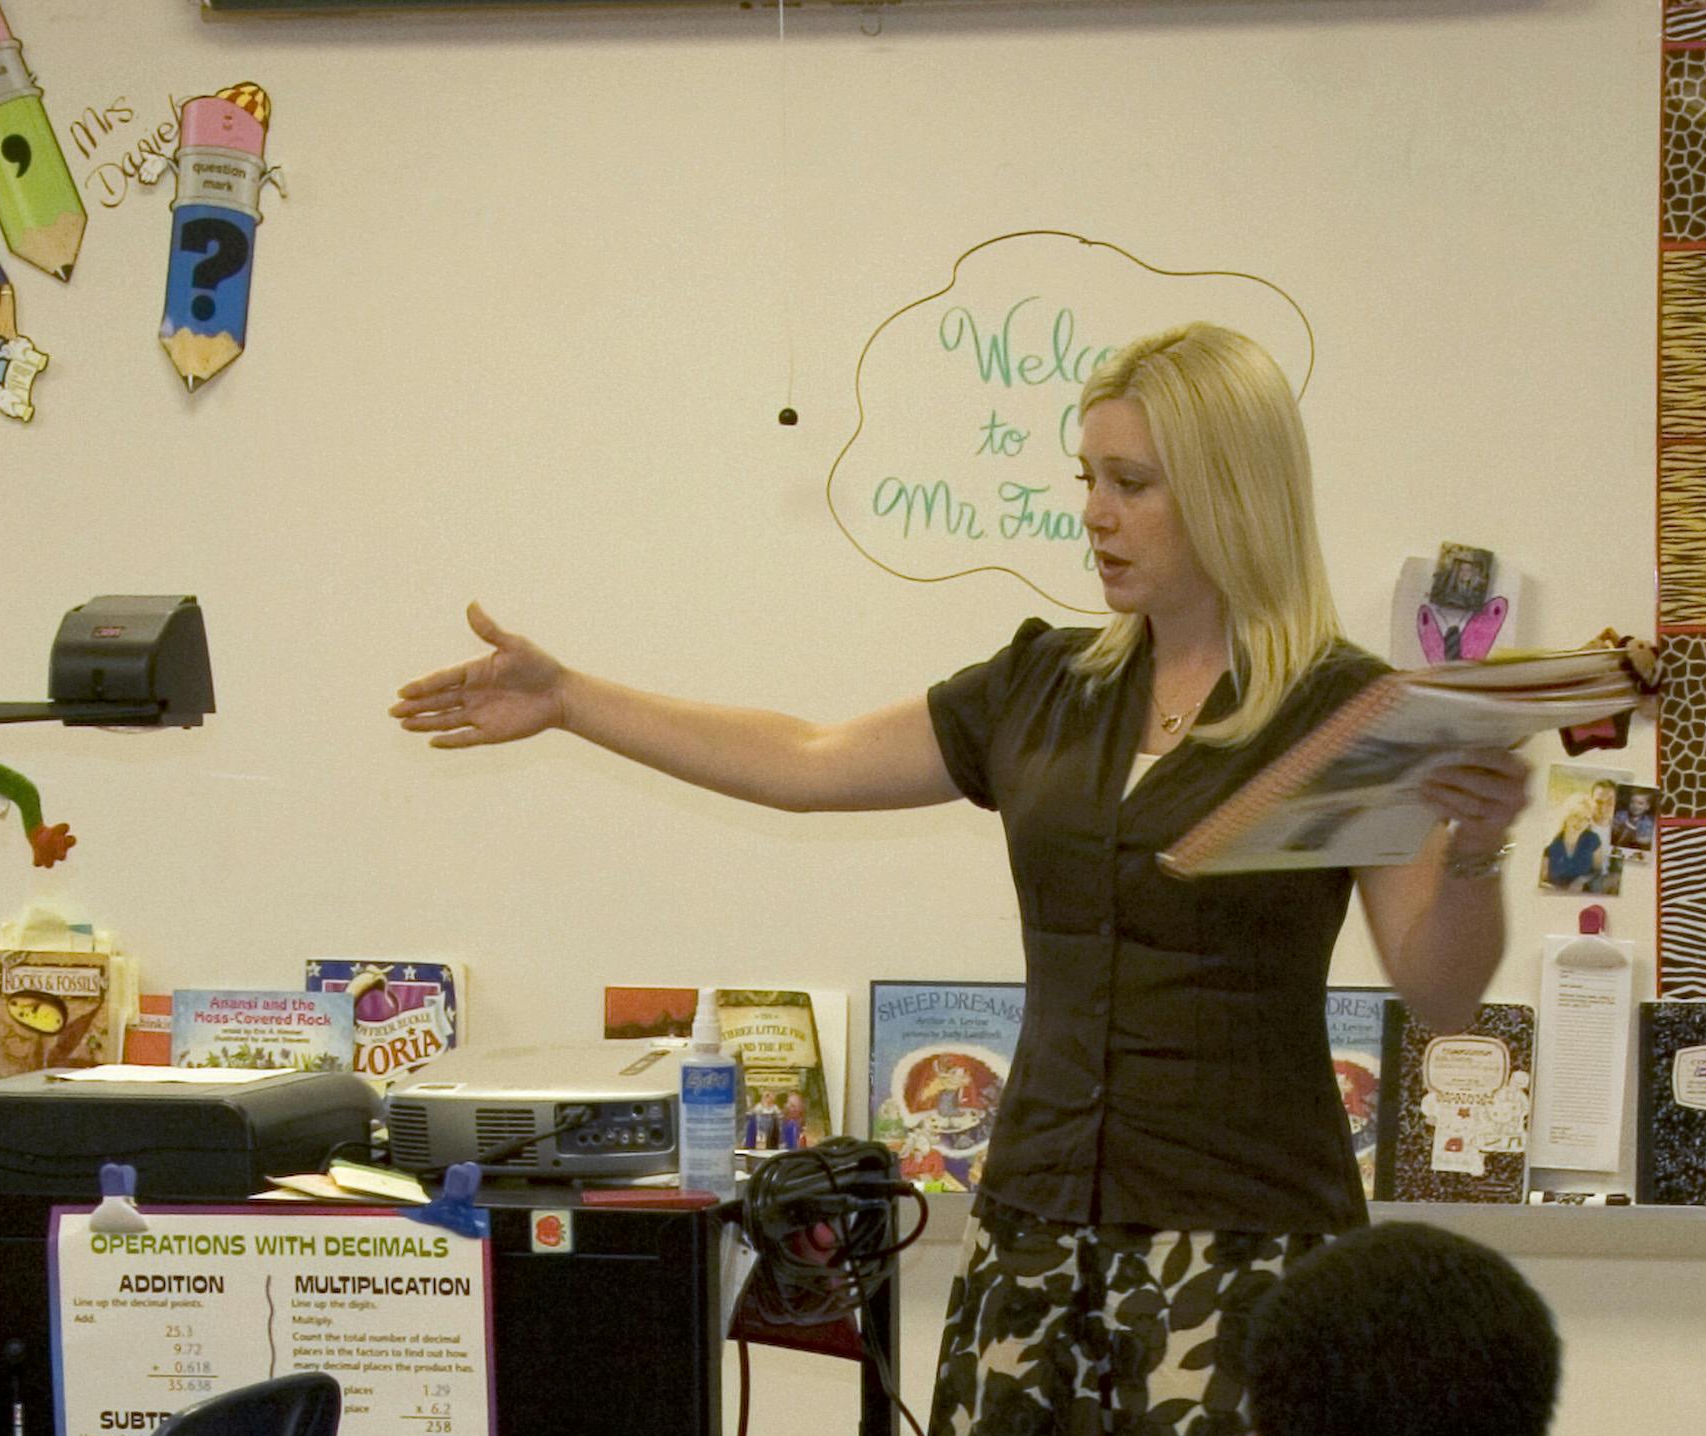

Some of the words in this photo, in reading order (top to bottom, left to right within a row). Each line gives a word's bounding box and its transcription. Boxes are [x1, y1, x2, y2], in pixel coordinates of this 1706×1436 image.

[192, 161, 247, 179] question
[202, 178, 235, 193] mark
[976, 410, 1029, 458] to
[4, 973, 44, 992] ROCKS
[56, 975, 100, 994] FOSSILS
[209, 997, 258, 1011] Anansi
[263, 998, 288, 1011] and
[292, 999, 317, 1012] the
[878, 991, 941, 1022] SHEEP
[945, 991, 1022, 1023] DREAMS
[194, 1011, 293, 1027] Moss-Covered
[296, 1013, 333, 1027] Rock
[90, 1234, 246, 1256] OPERATIONS
[255, 1235, 316, 1257] WITH
[324, 1236, 449, 1258] DECIMALS
[119, 1274, 225, 1294] ADDITION
[295, 1275, 470, 1296] MULTIPLICATION
[73, 1299, 94, 1308] Line
[96, 1300, 108, 1310] up
[111, 1299, 127, 1308] the
[131, 1298, 167, 1309] decimal
[165, 1326, 193, 1338] 25.3
[173, 1344, 202, 1356] 9.72
[175, 1361, 211, 1373] 0.618
[168, 1379, 212, 1392] 35.638
[423, 1384, 451, 1397] 1.29
[431, 1403, 451, 1415] 6.2
[425, 1421, 452, 1433] 258
